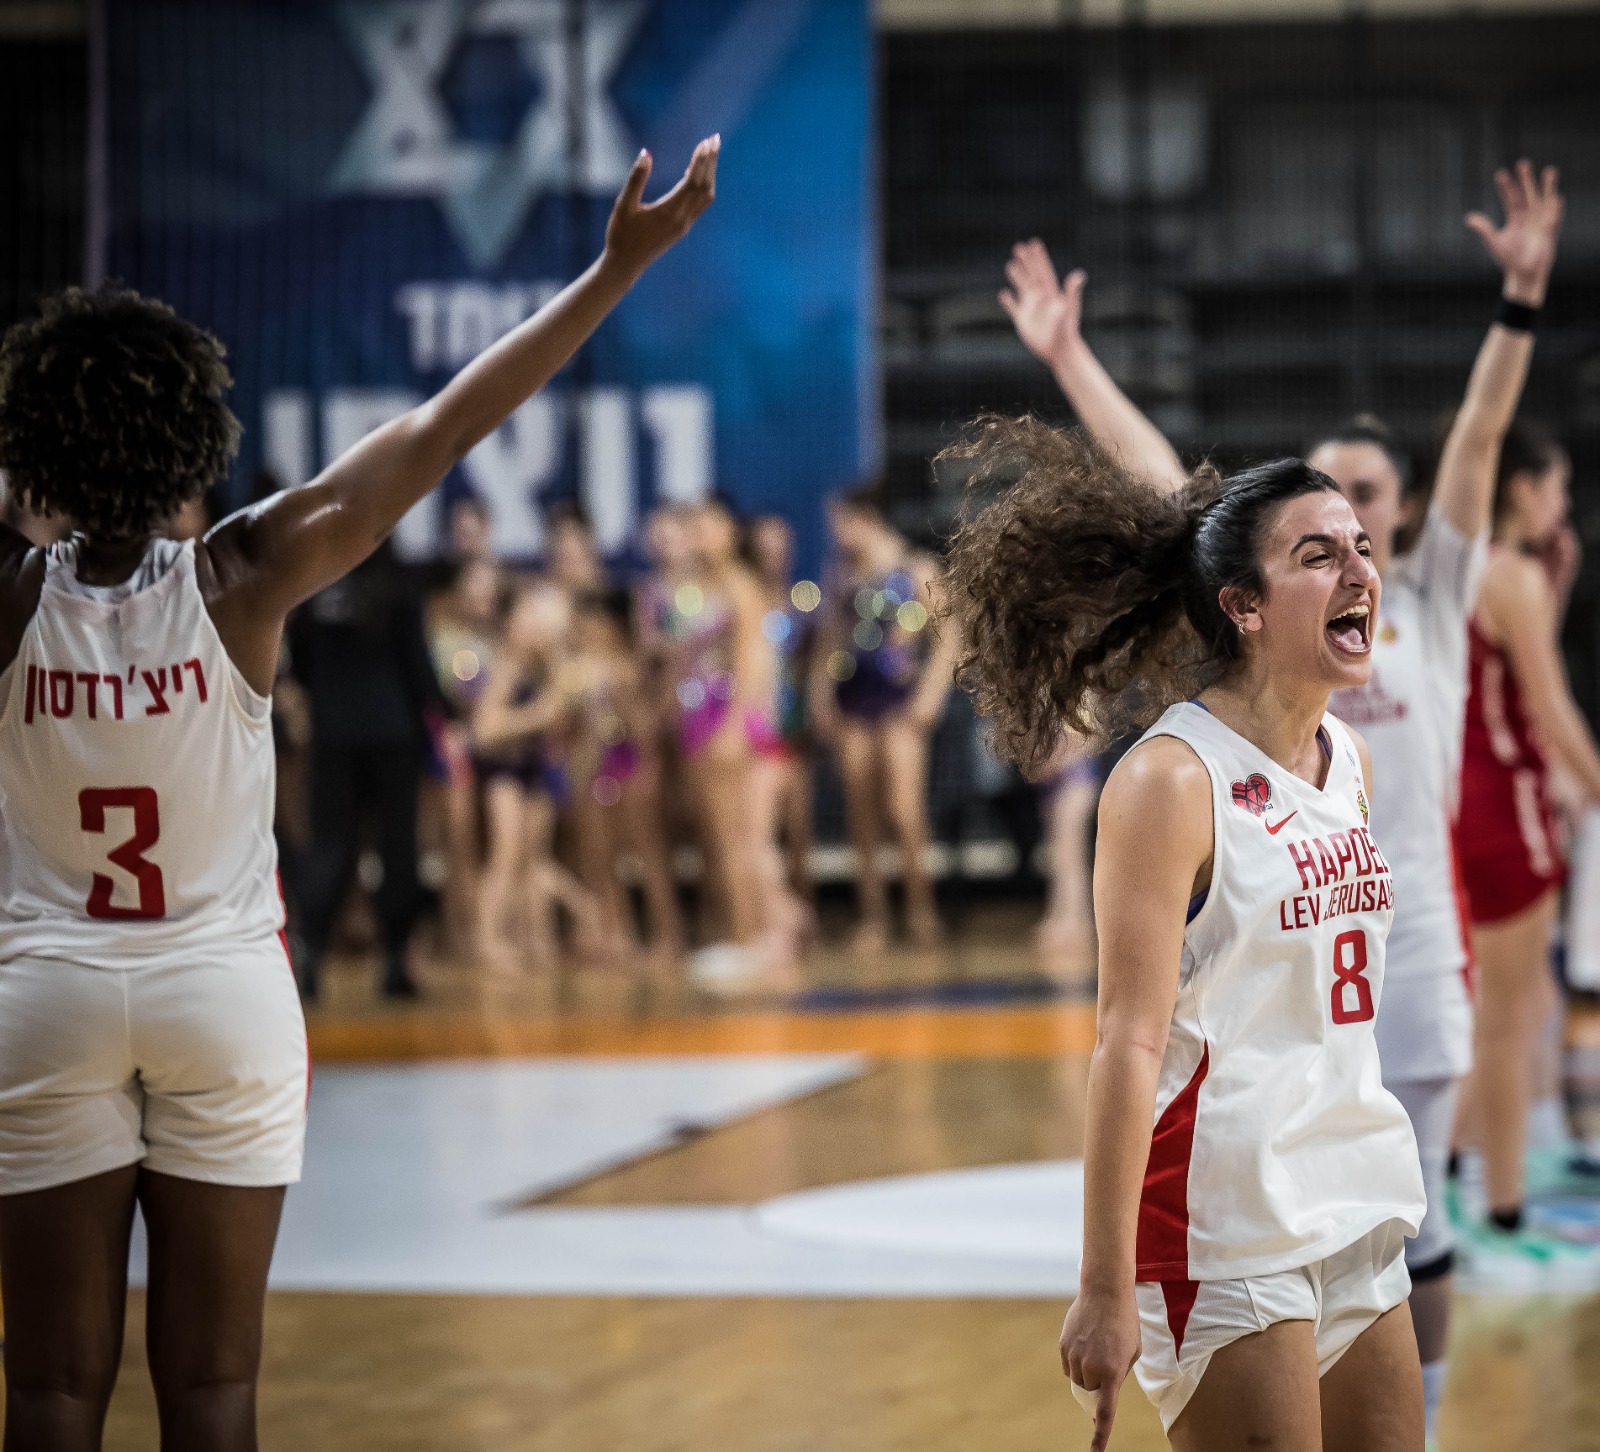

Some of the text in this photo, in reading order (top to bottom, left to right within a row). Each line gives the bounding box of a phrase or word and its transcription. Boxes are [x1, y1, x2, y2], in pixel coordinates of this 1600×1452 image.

[24, 657, 208, 725] ריצ'רדסון
[78, 786, 166, 919] 3
[1280, 893, 1320, 931] LEV
[1331, 929, 1375, 1025] 8
